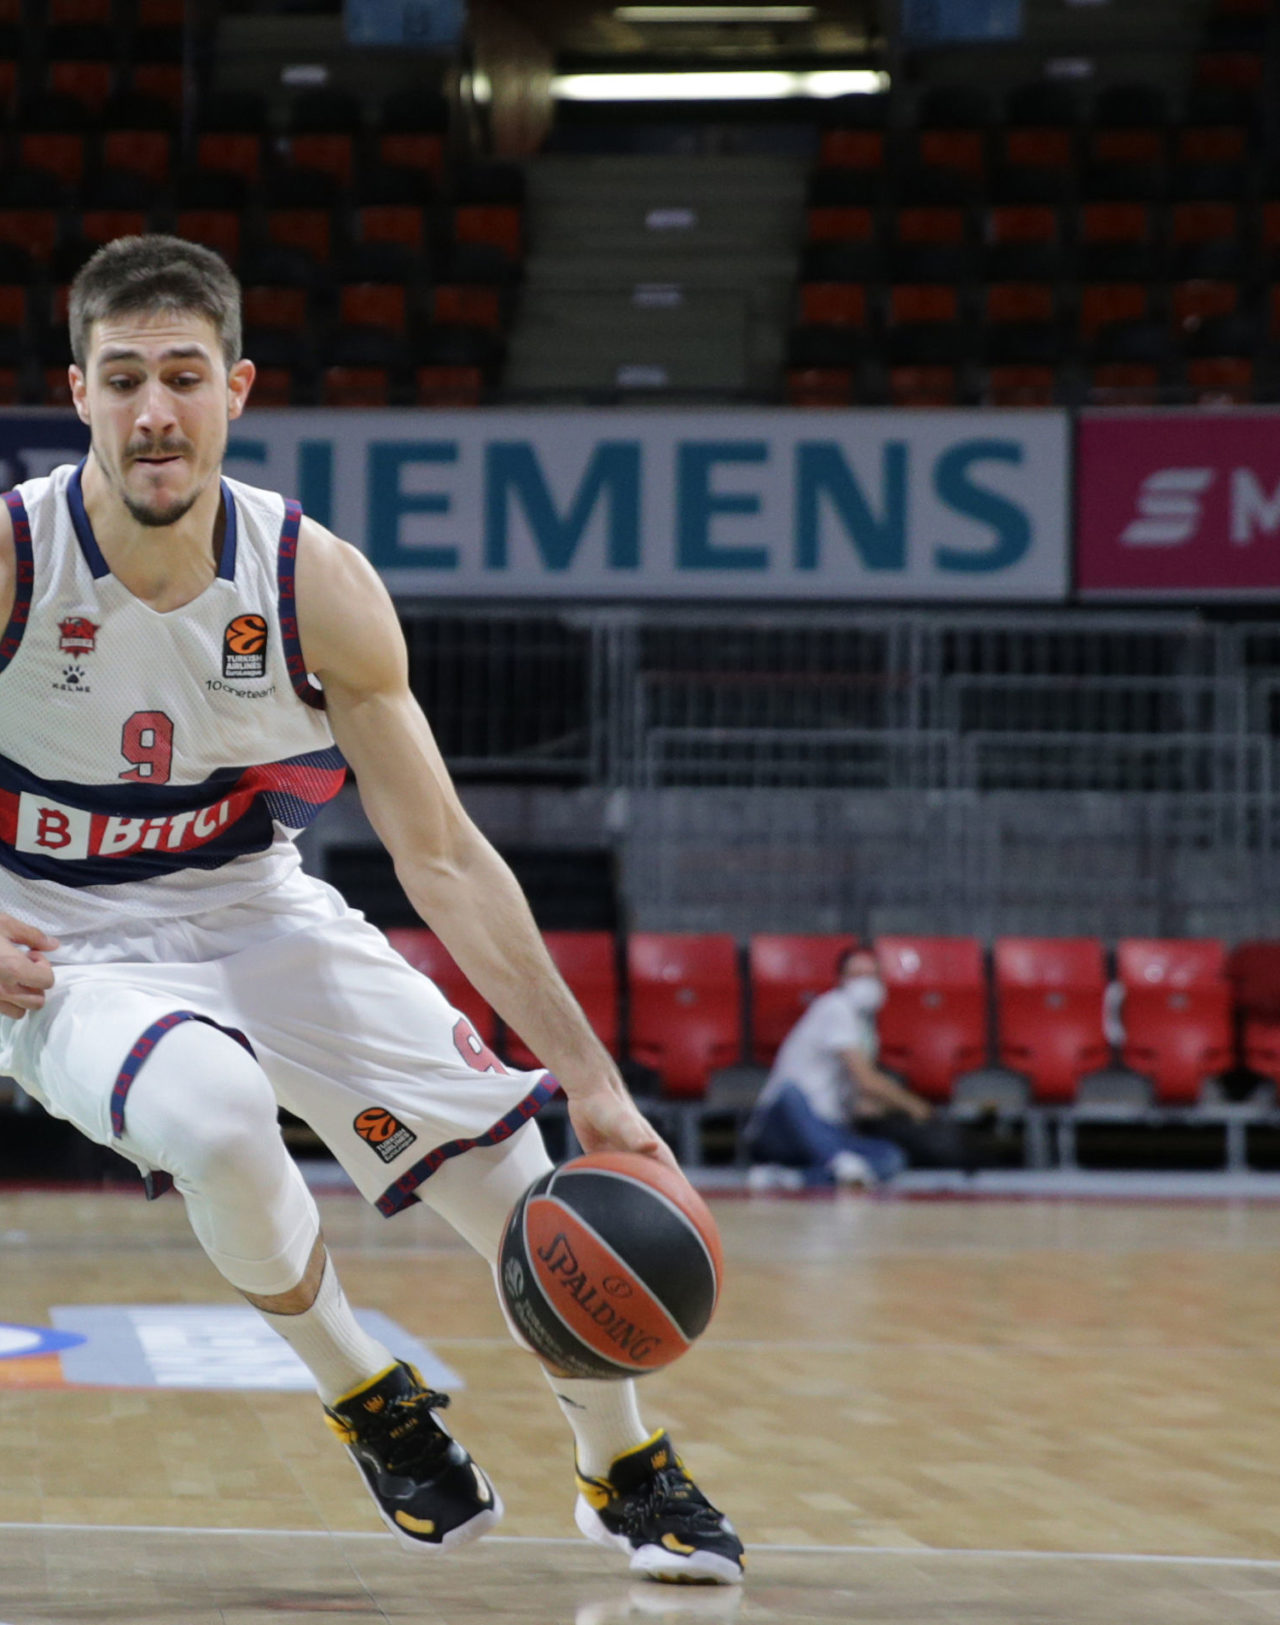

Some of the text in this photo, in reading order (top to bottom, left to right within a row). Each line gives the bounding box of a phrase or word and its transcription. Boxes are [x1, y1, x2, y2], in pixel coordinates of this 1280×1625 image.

[224, 435, 1033, 573] IEMENS
[119, 710, 174, 785] 9
[537, 1232, 662, 1362] SPALDING
